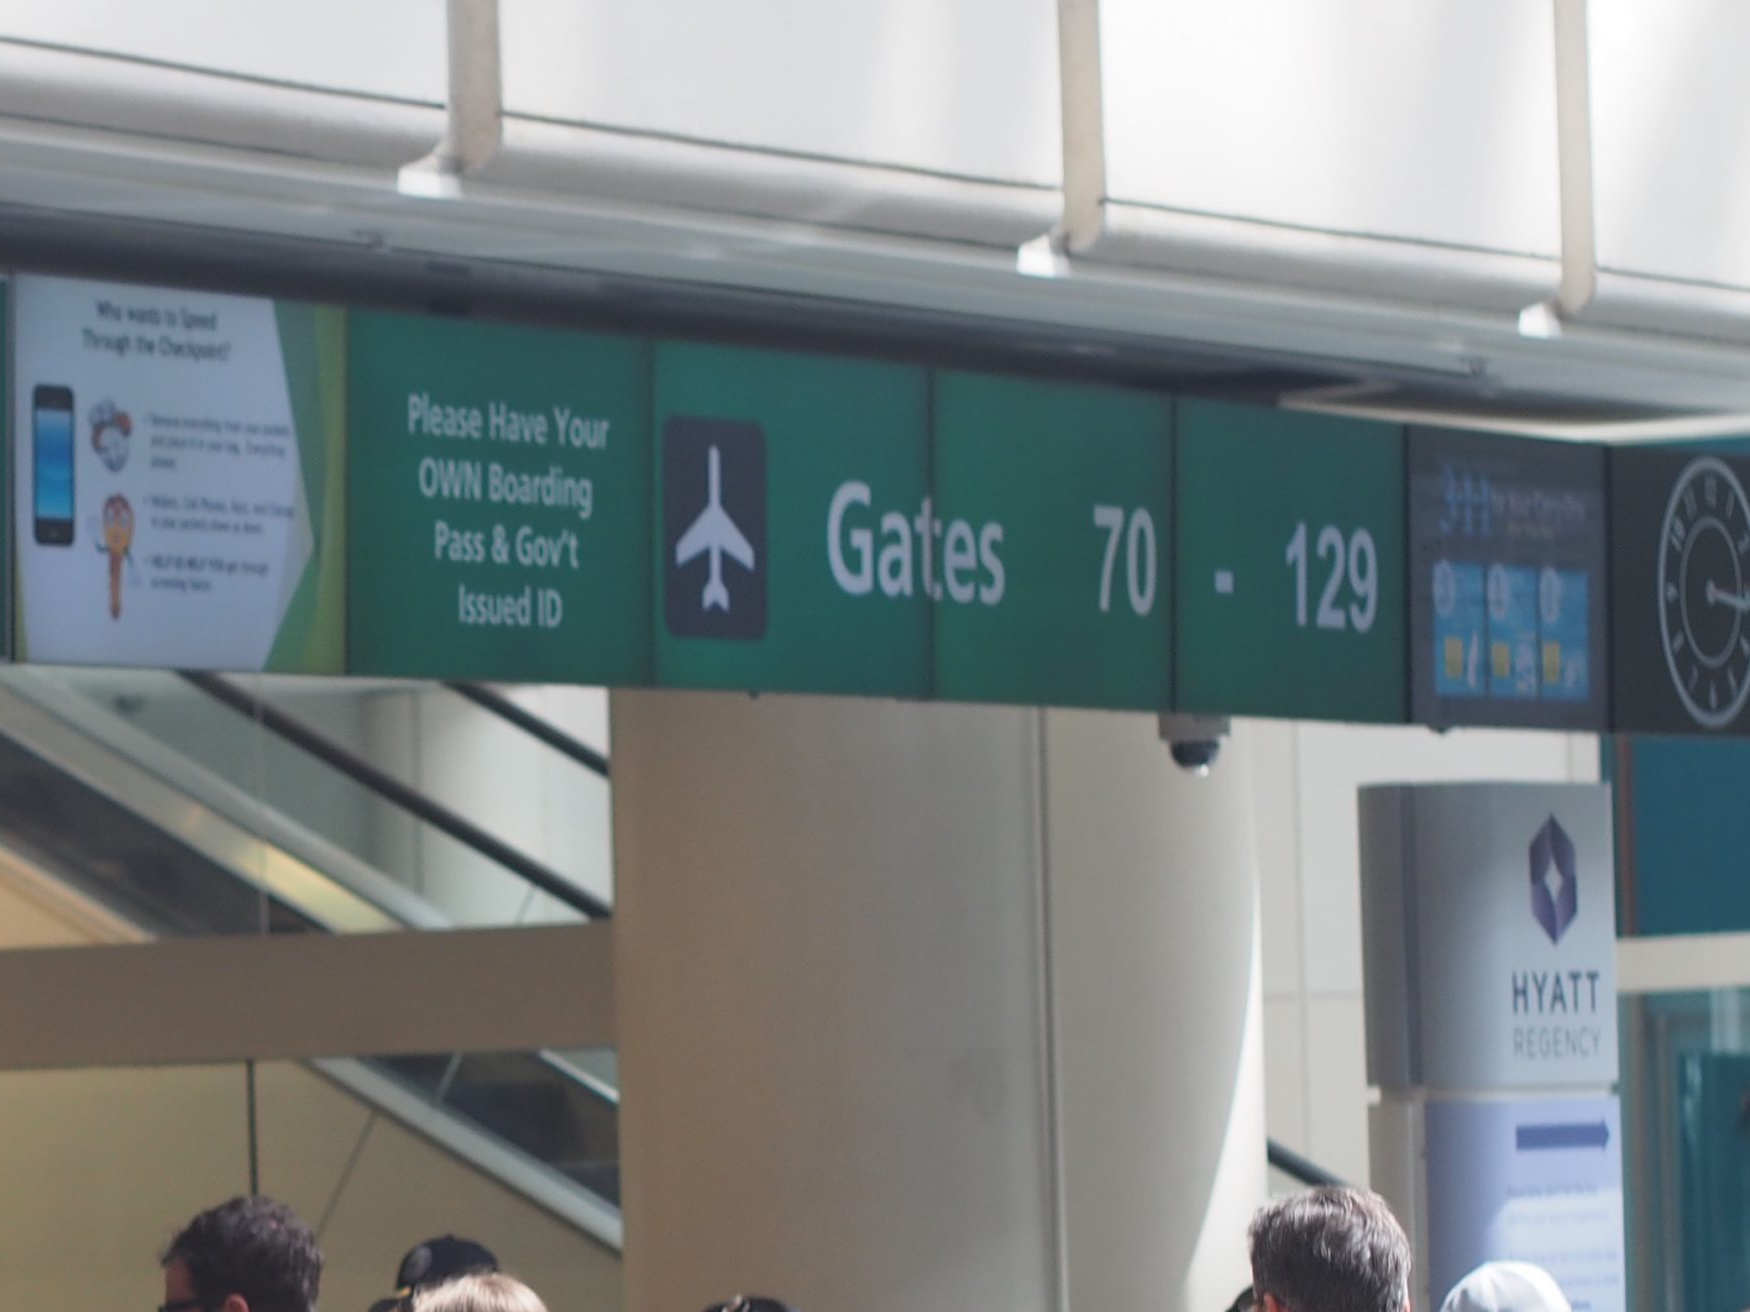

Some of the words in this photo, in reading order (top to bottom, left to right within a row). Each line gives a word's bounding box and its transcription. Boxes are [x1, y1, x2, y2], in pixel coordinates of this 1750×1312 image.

[407, 393, 483, 439] Please
[488, 400, 549, 445] Have
[553, 405, 610, 450] Your
[418, 456, 482, 501] OWN
[488, 462, 594, 520] Boarding
[434, 519, 485, 562] Pass
[490, 523, 510, 565] &
[515, 525, 580, 569] Gov't
[826, 480, 1006, 606] Gates
[1092, 504, 1158, 617] 70
[1286, 520, 1379, 634] 129
[458, 583, 531, 627] Issued
[537, 587, 563, 629] ID
[1511, 969, 1601, 1015] HYATT
[1513, 1025, 1602, 1060] REGENCY
